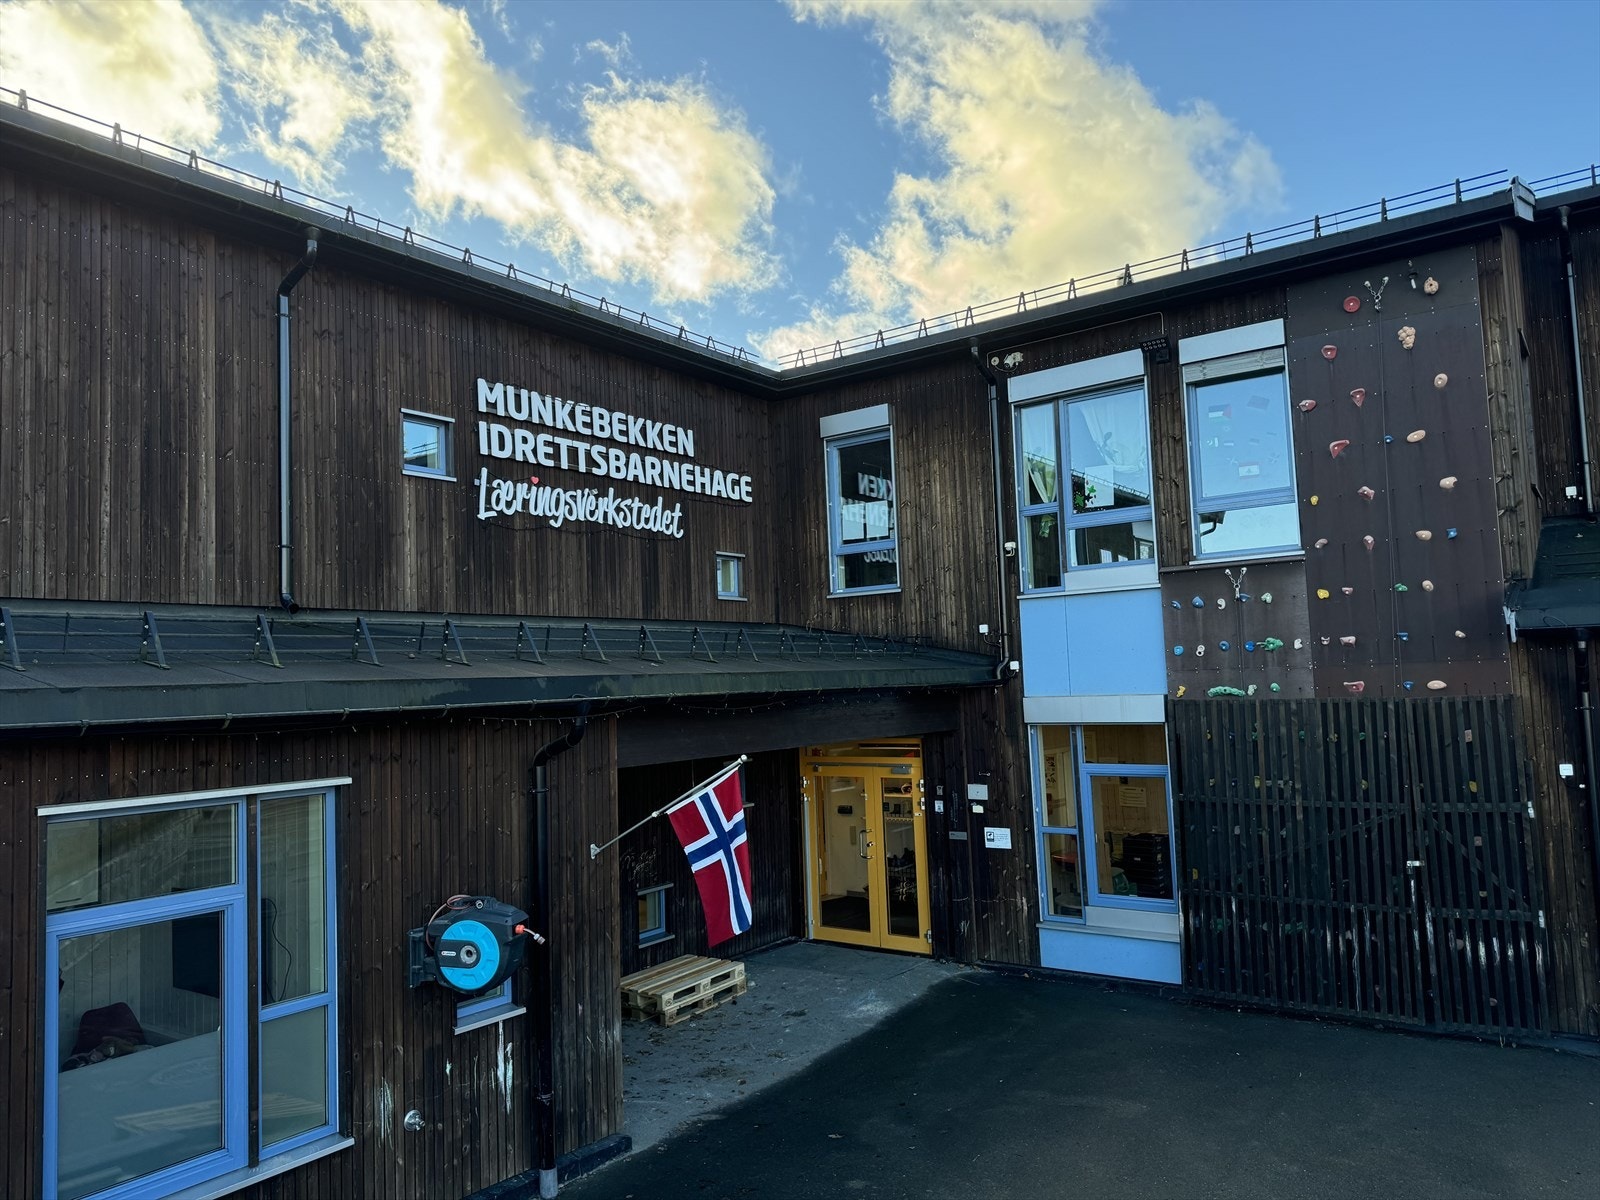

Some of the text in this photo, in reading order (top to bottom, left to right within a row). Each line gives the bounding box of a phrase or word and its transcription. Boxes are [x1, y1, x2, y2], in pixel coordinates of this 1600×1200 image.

[476, 377, 695, 457] MUNKEBEKKEN
[477, 420, 753, 503] IDRETTSBARNEHAGE
[476, 467, 684, 539] Læringsverkstedet
